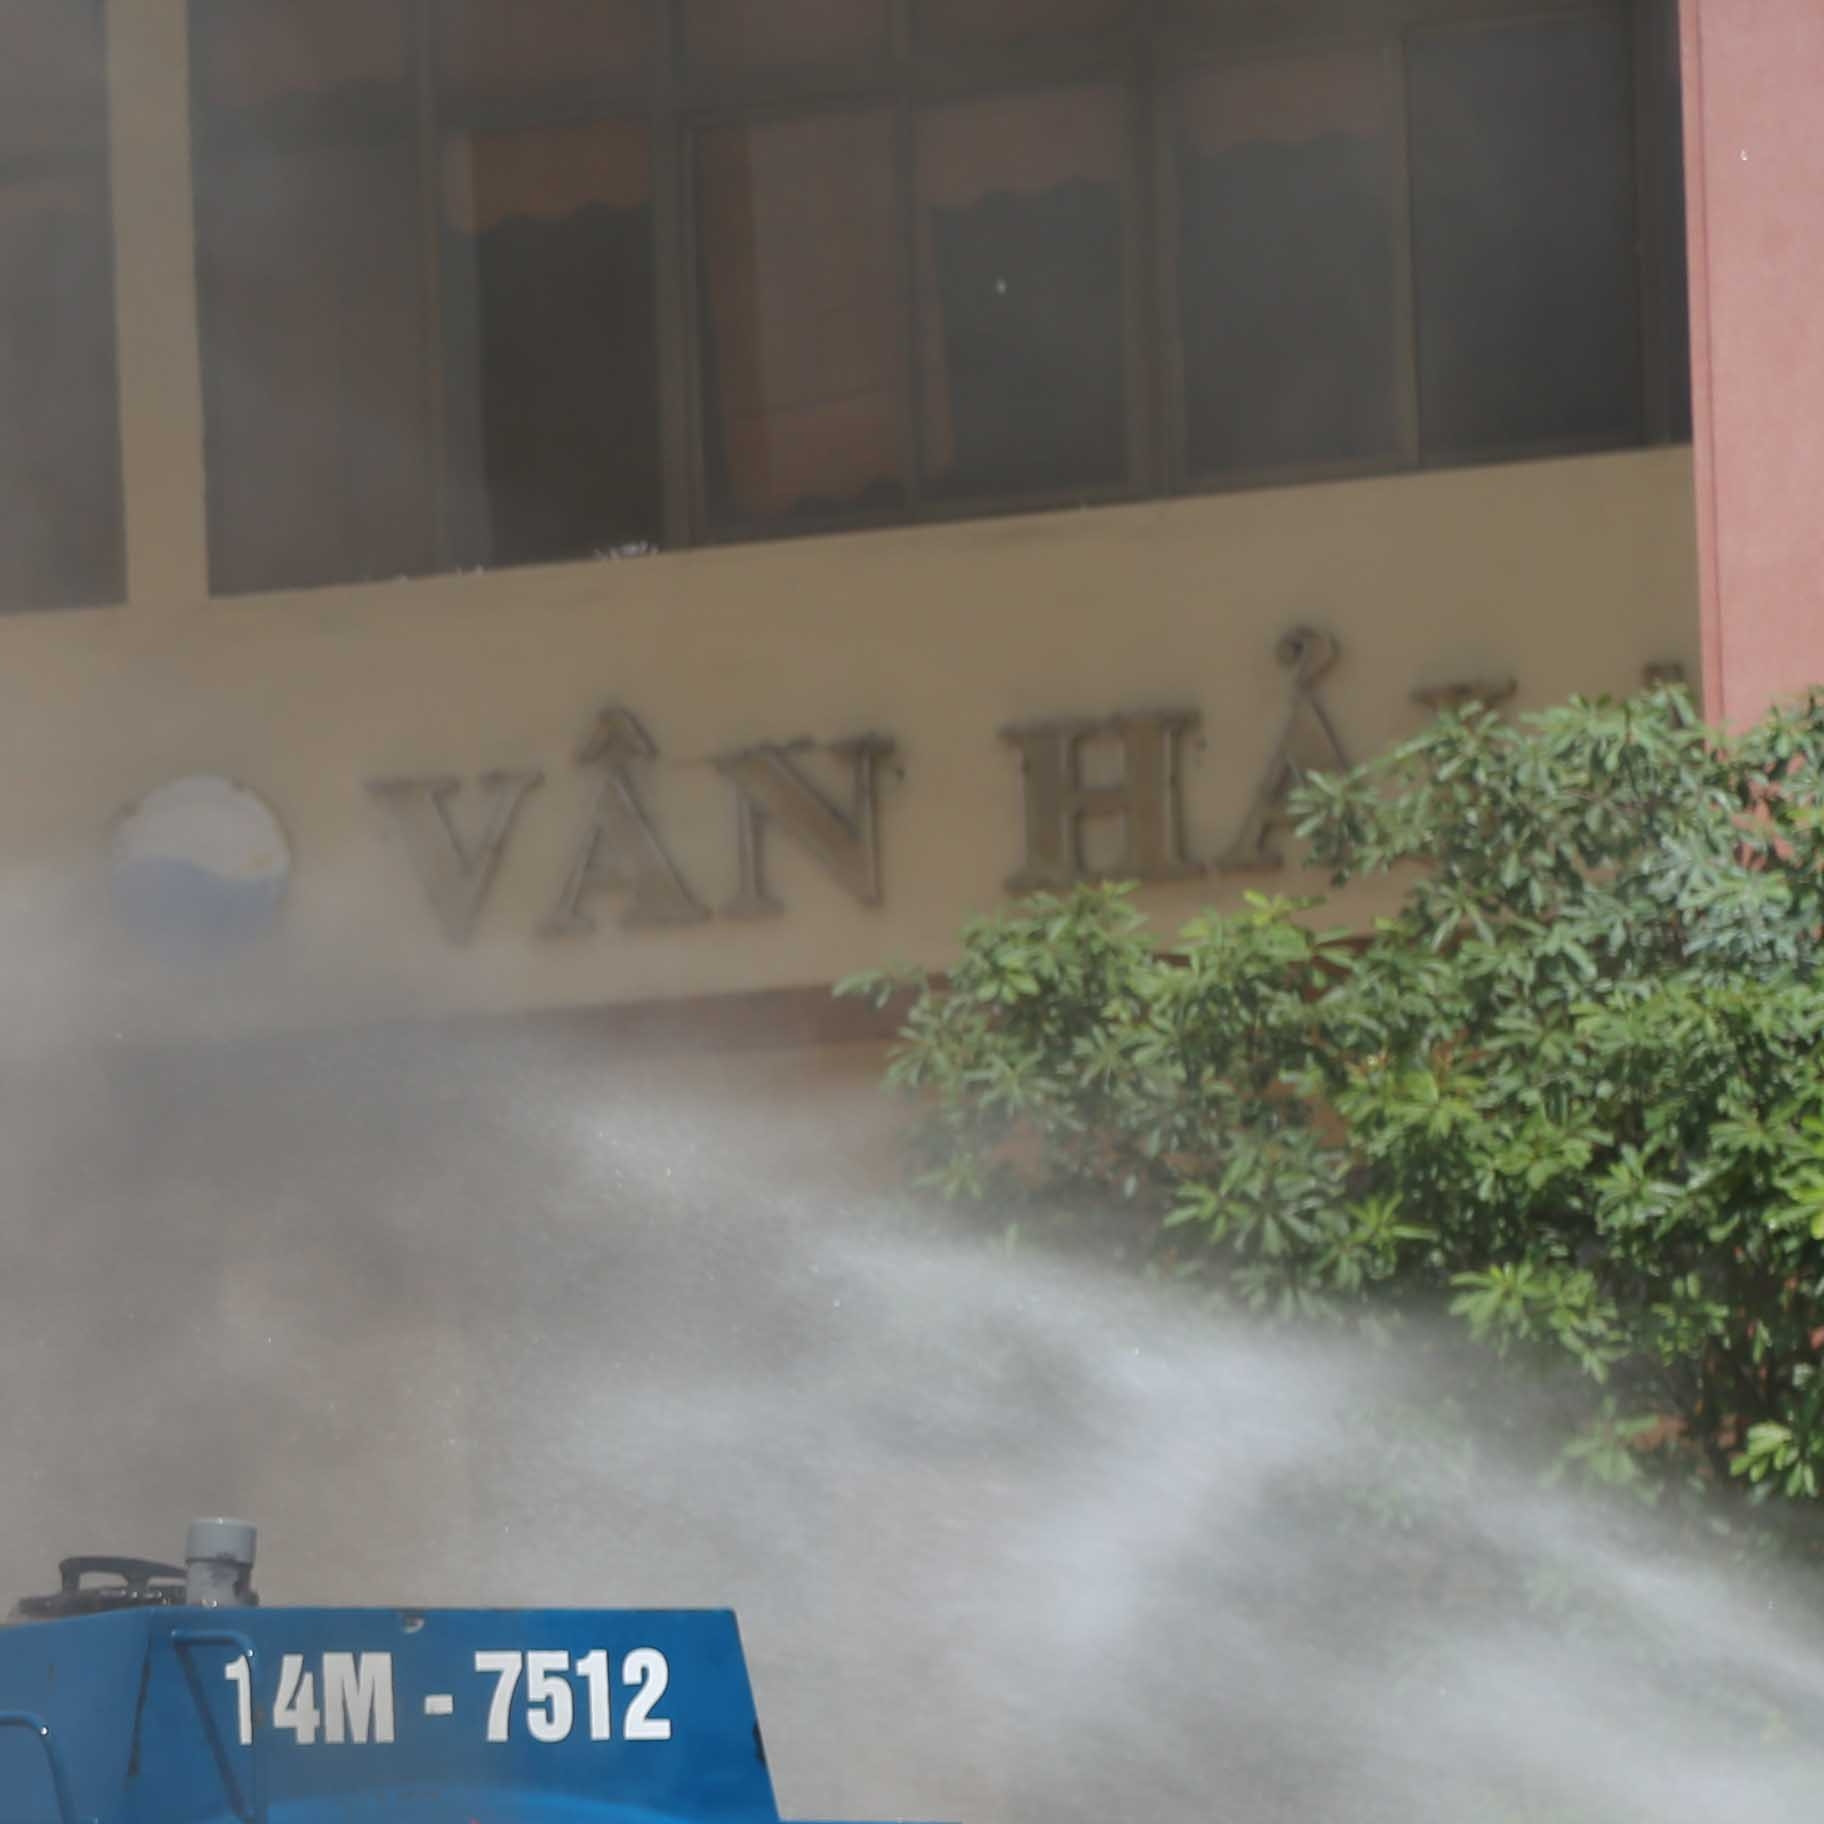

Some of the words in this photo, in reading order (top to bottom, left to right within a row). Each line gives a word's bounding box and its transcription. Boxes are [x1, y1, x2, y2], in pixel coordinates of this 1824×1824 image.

[362, 704, 904, 948] VÂN
[224, 1650, 395, 1746] 14M
[474, 1646, 672, 1744] 7512
